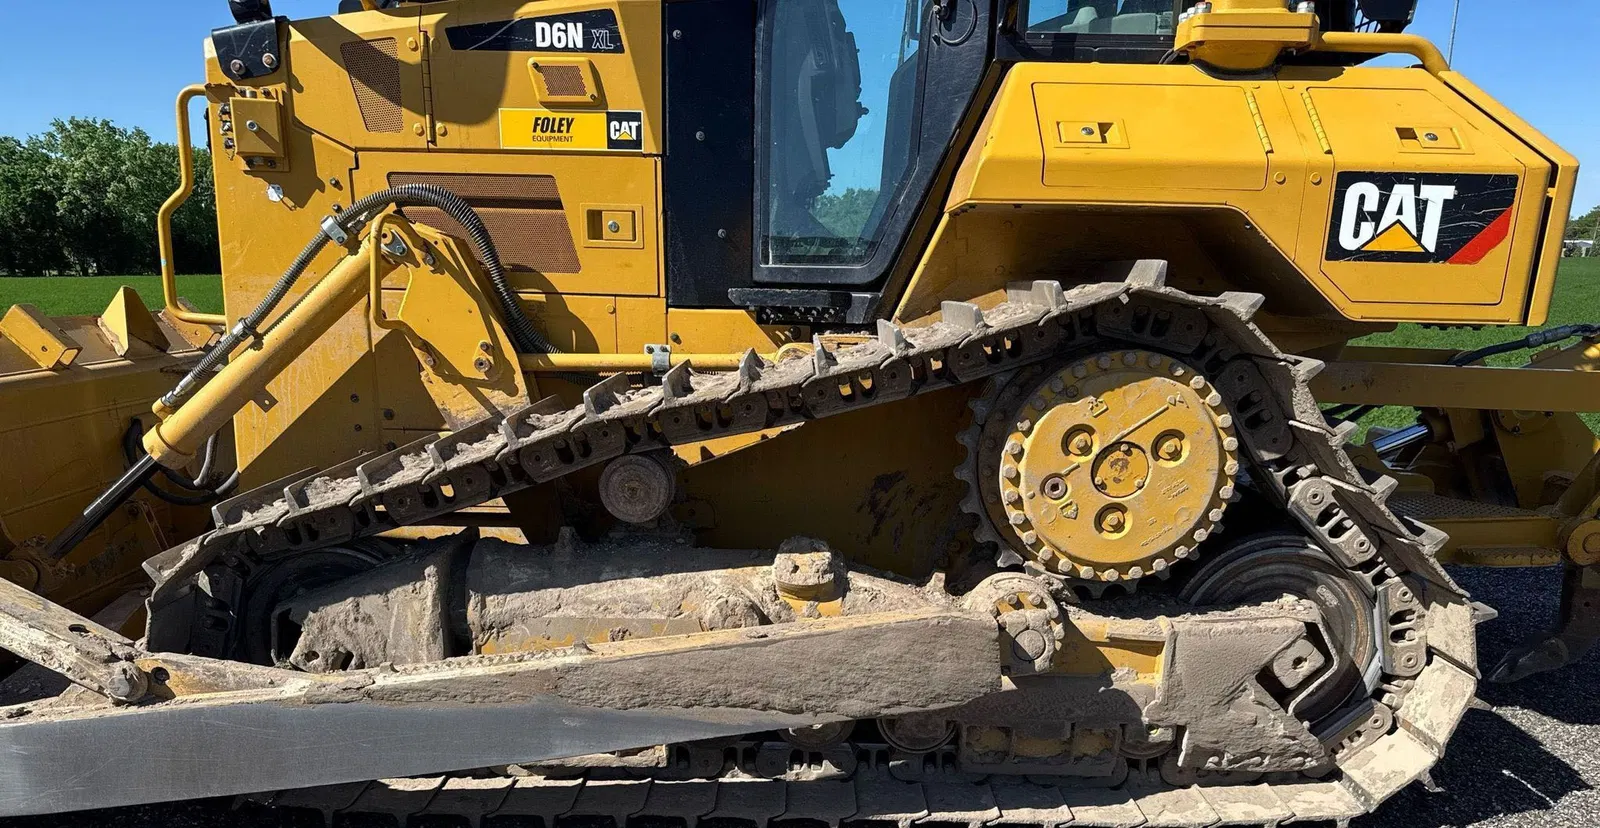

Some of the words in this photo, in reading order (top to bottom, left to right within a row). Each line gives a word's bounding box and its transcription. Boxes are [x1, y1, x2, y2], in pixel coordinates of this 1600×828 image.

[535, 21, 583, 49] D6N
[591, 29, 614, 50] XL
[532, 116, 575, 134] FOLEY
[609, 120, 639, 141] CAT
[532, 135, 574, 143] EQUIPMENT
[1338, 181, 1456, 253] CAT
